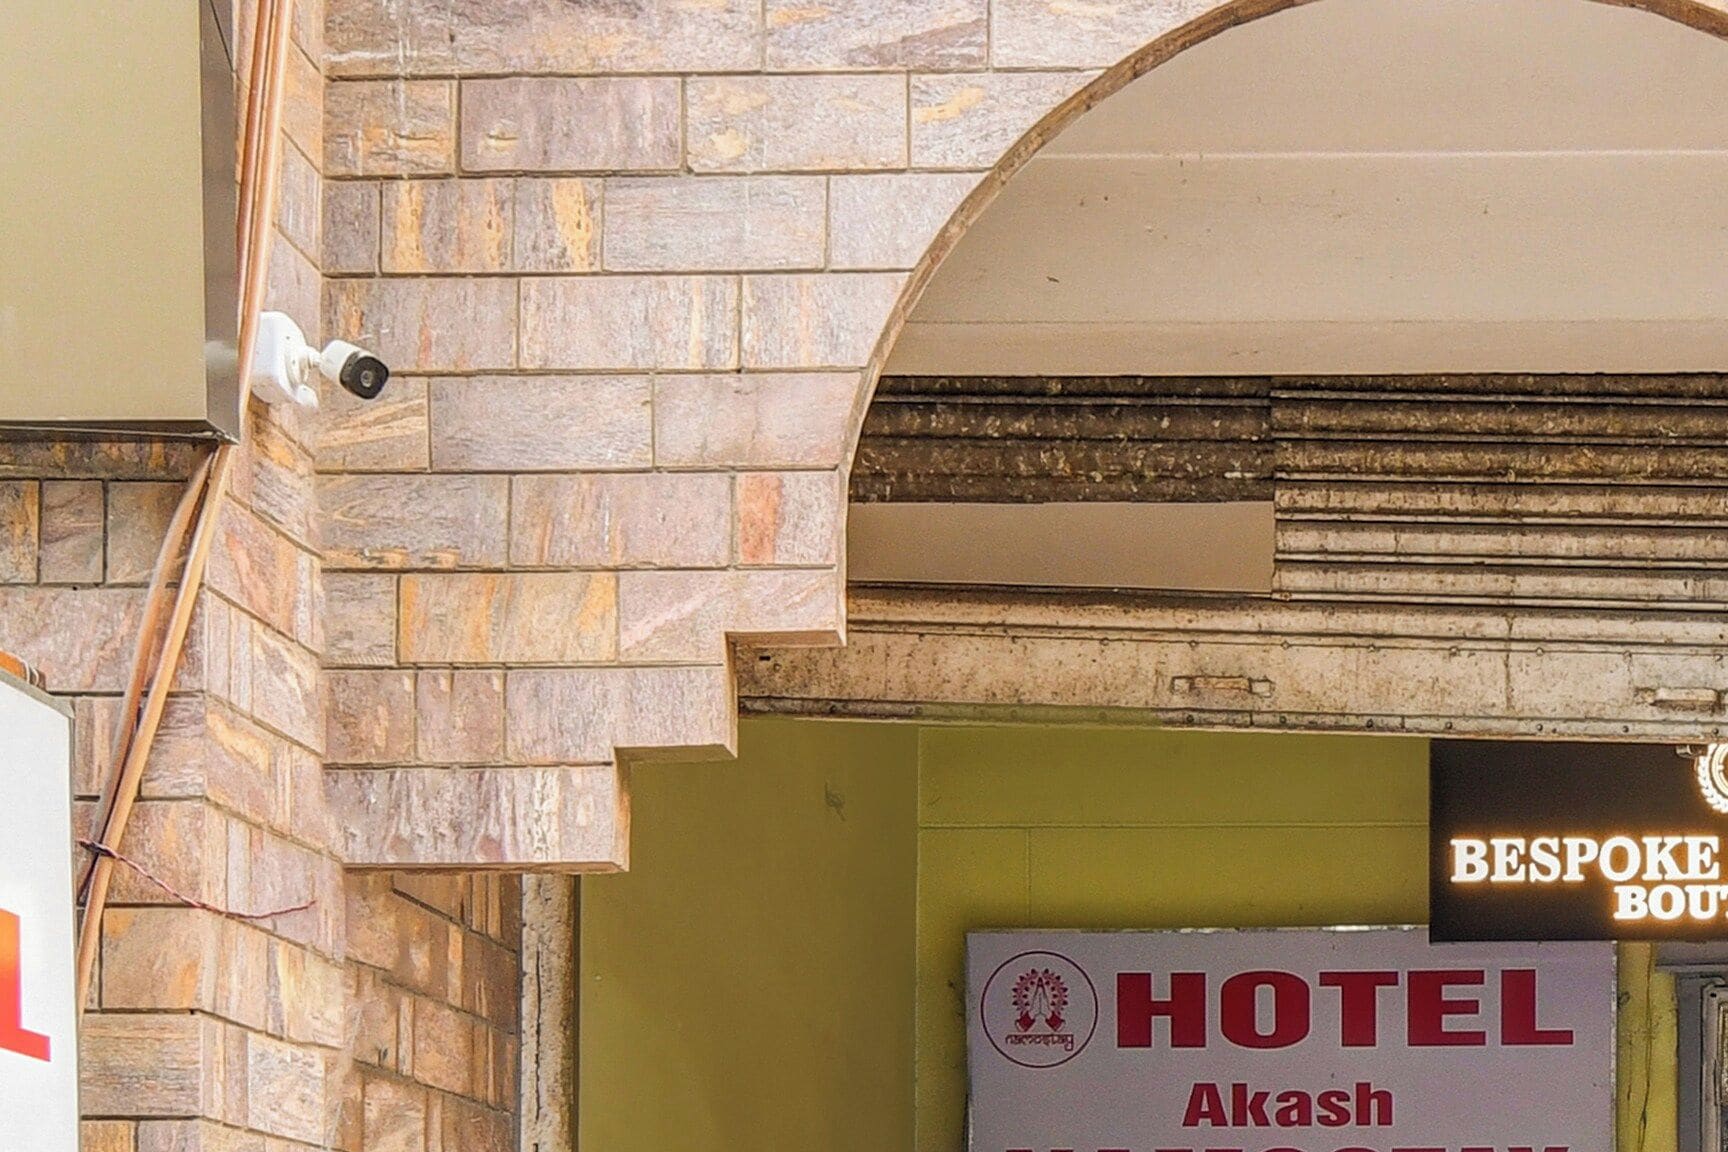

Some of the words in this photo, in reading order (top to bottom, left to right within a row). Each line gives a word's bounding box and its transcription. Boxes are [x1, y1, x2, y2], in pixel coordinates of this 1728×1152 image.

[1450, 835, 1720, 884] BESPOKE
[1116, 969, 1575, 1049] HOTEL
[1182, 1082, 1394, 1127] Akash
